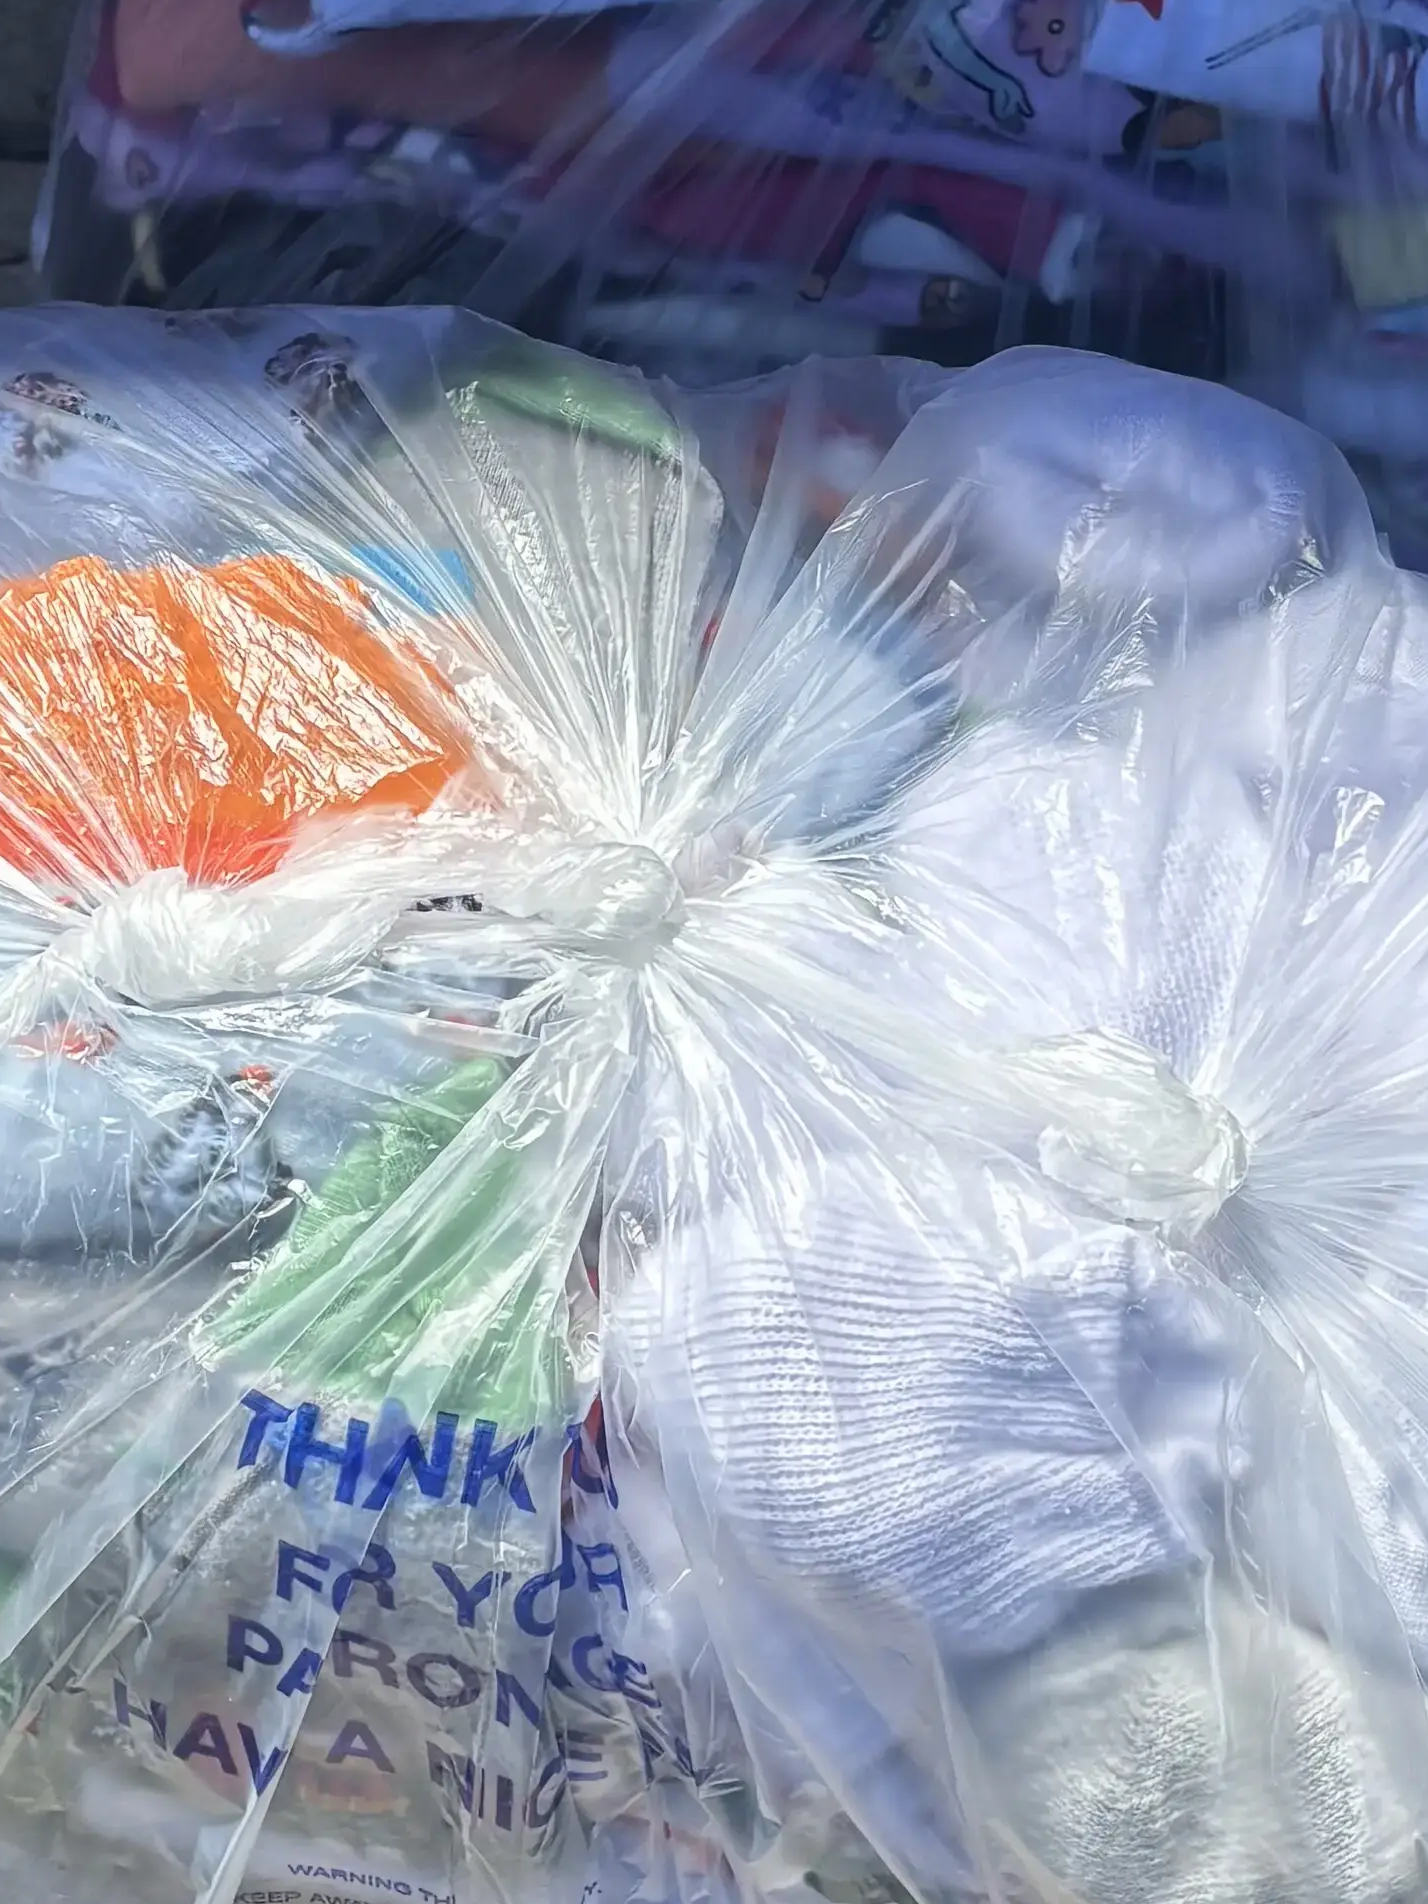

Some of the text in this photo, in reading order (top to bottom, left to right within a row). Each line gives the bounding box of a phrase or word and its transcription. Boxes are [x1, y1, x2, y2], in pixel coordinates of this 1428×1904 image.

[113, 1677, 289, 1797] HAV
[326, 1720, 395, 1774] A
[288, 1864, 413, 1895] WARNING
[233, 1891, 302, 1904] KEEP
